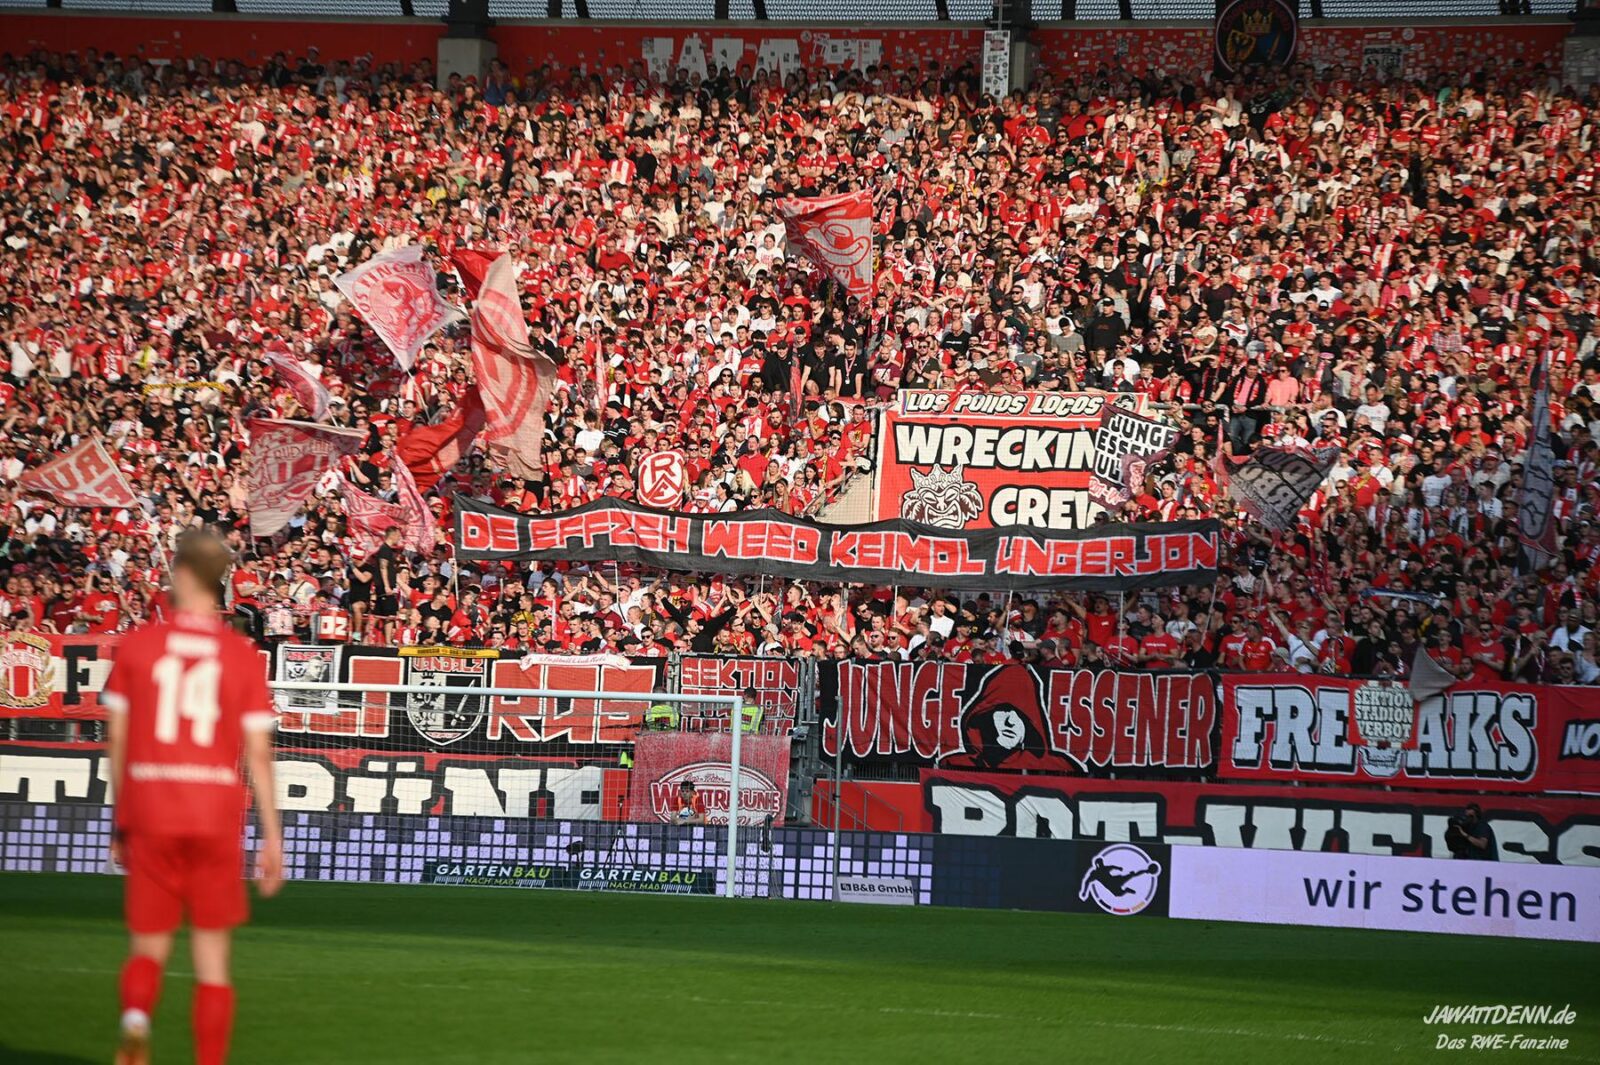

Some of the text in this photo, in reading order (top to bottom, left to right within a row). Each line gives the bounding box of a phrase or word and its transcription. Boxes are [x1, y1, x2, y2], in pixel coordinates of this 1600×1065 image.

[907, 393, 949, 412] LOS
[1030, 394, 1103, 417] LOCOS
[460, 511, 519, 552] DE
[529, 508, 692, 553] EFFZEH
[830, 531, 986, 576] KEIMOL
[996, 531, 1218, 577] UNGERJON
[681, 657, 799, 690] SEKTION
[152, 654, 223, 747] 14
[1355, 690, 1414, 708] SEKTION
[823, 659, 1216, 768] JUNGE ESSENER
[1355, 705, 1414, 723] STADION
[436, 864, 551, 879] GARTENBAU
[579, 868, 697, 884] GARTENBAU
[853, 884, 914, 895] B&B GmbH
[1303, 870, 1577, 922] wir stehen
